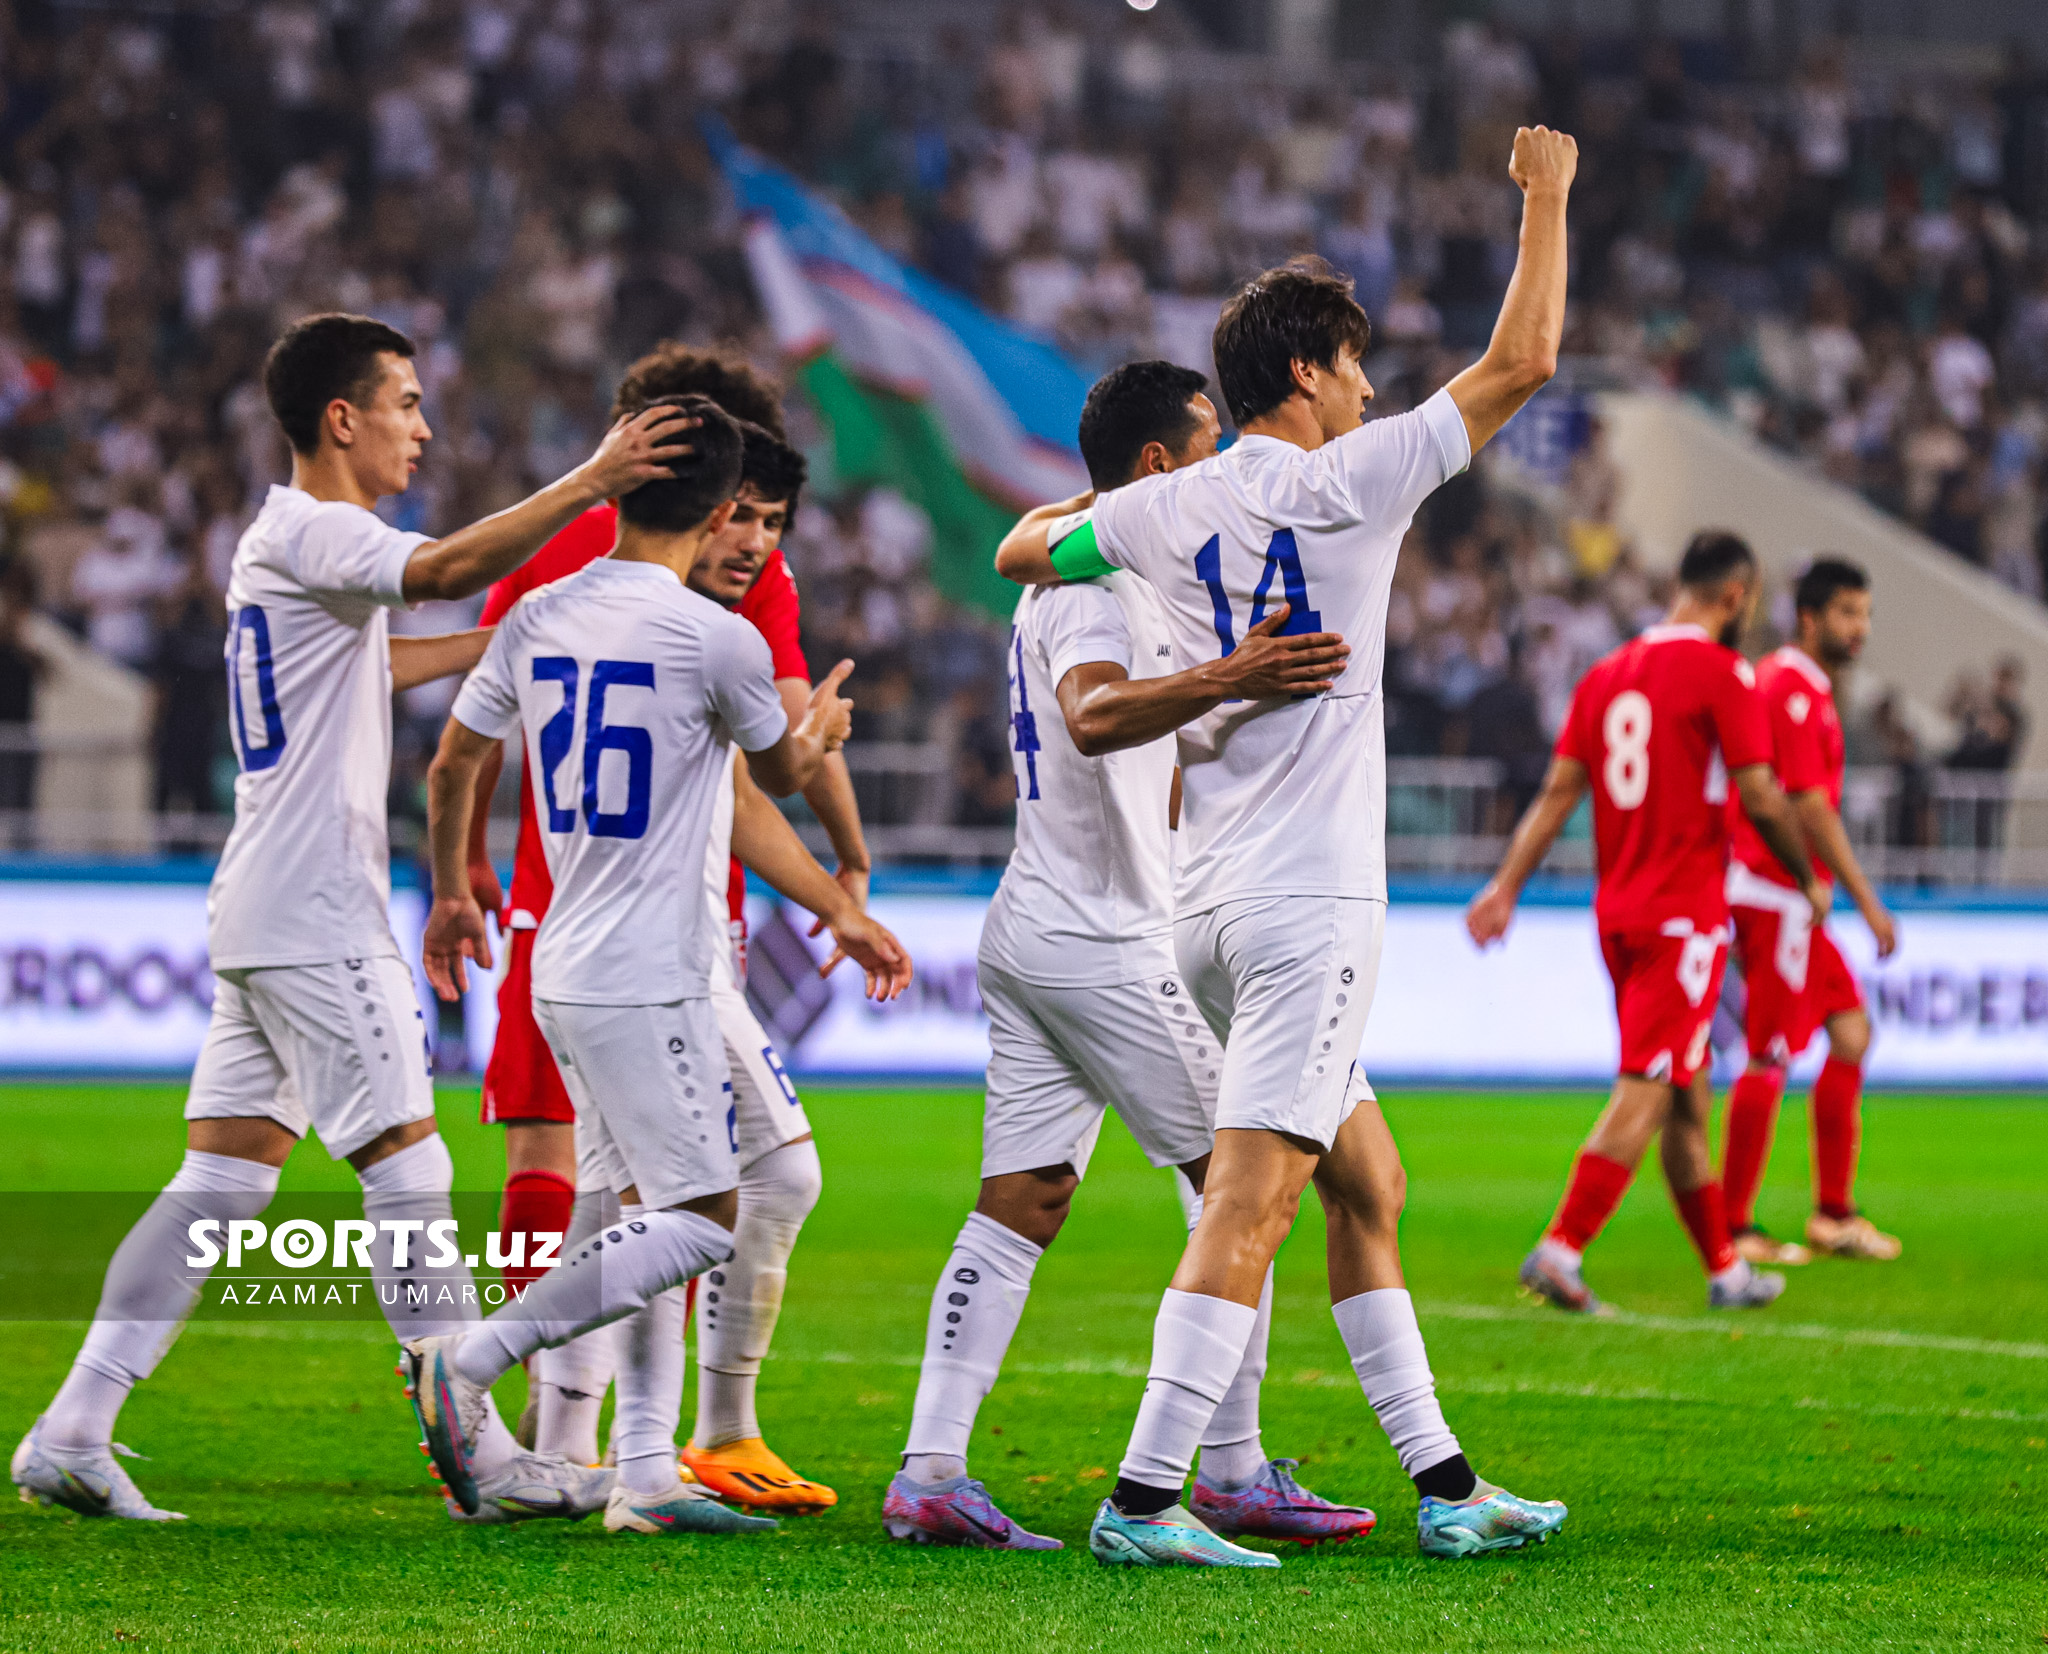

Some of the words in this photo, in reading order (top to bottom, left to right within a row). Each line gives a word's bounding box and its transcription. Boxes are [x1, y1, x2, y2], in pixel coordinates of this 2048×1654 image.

[225, 605, 287, 772] 0
[1194, 527, 1323, 704] 14
[532, 656, 656, 840] 26
[1603, 690, 1653, 811] 8
